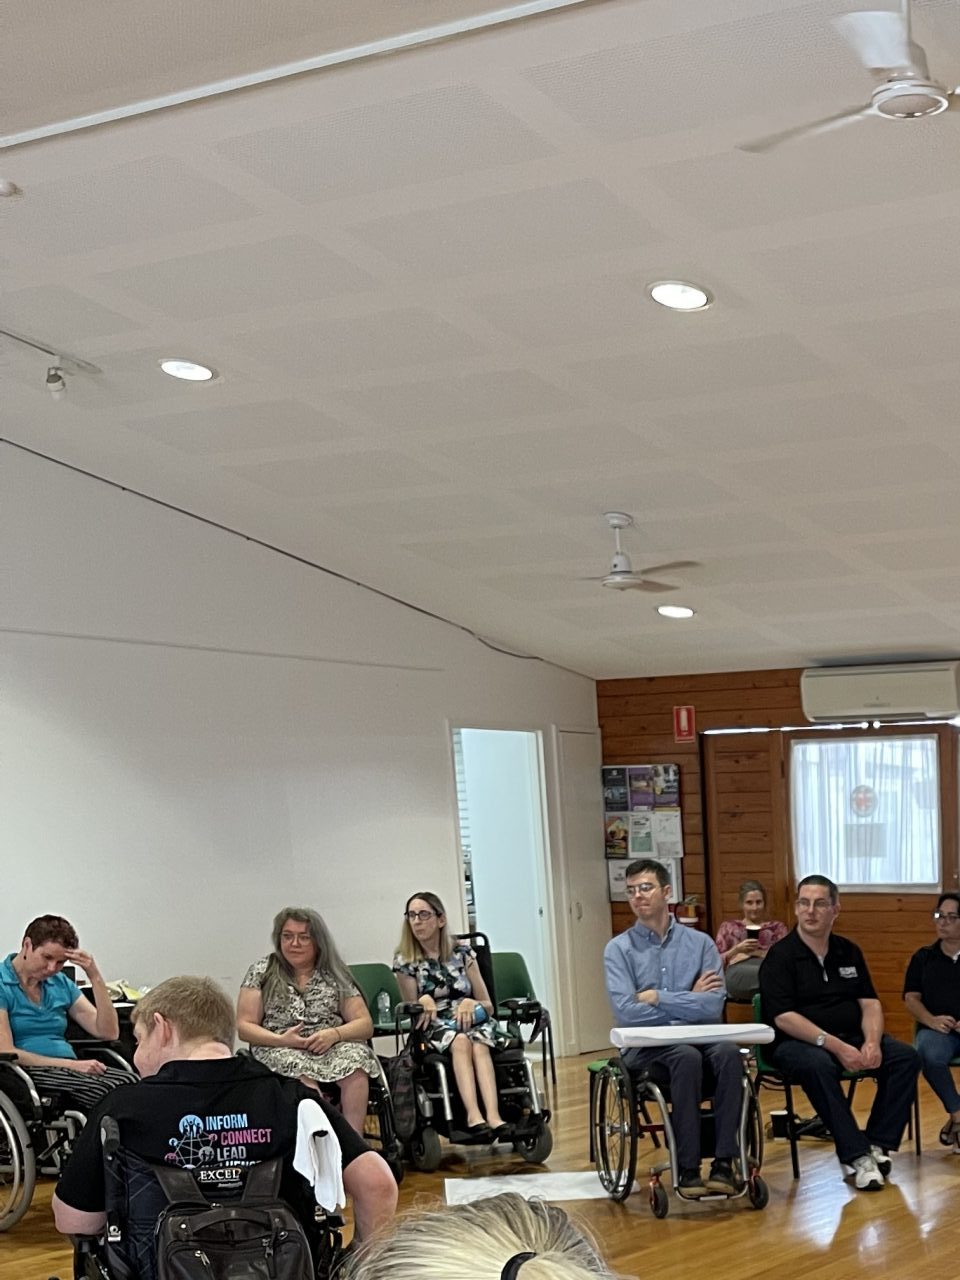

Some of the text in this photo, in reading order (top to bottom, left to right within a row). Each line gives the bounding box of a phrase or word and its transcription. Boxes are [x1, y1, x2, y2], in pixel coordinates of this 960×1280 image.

[205, 1114, 248, 1131] INFORM
[221, 1129, 272, 1146] CONNECT
[216, 1146, 247, 1161] LEAD
[200, 1169, 239, 1180] EXCEL
